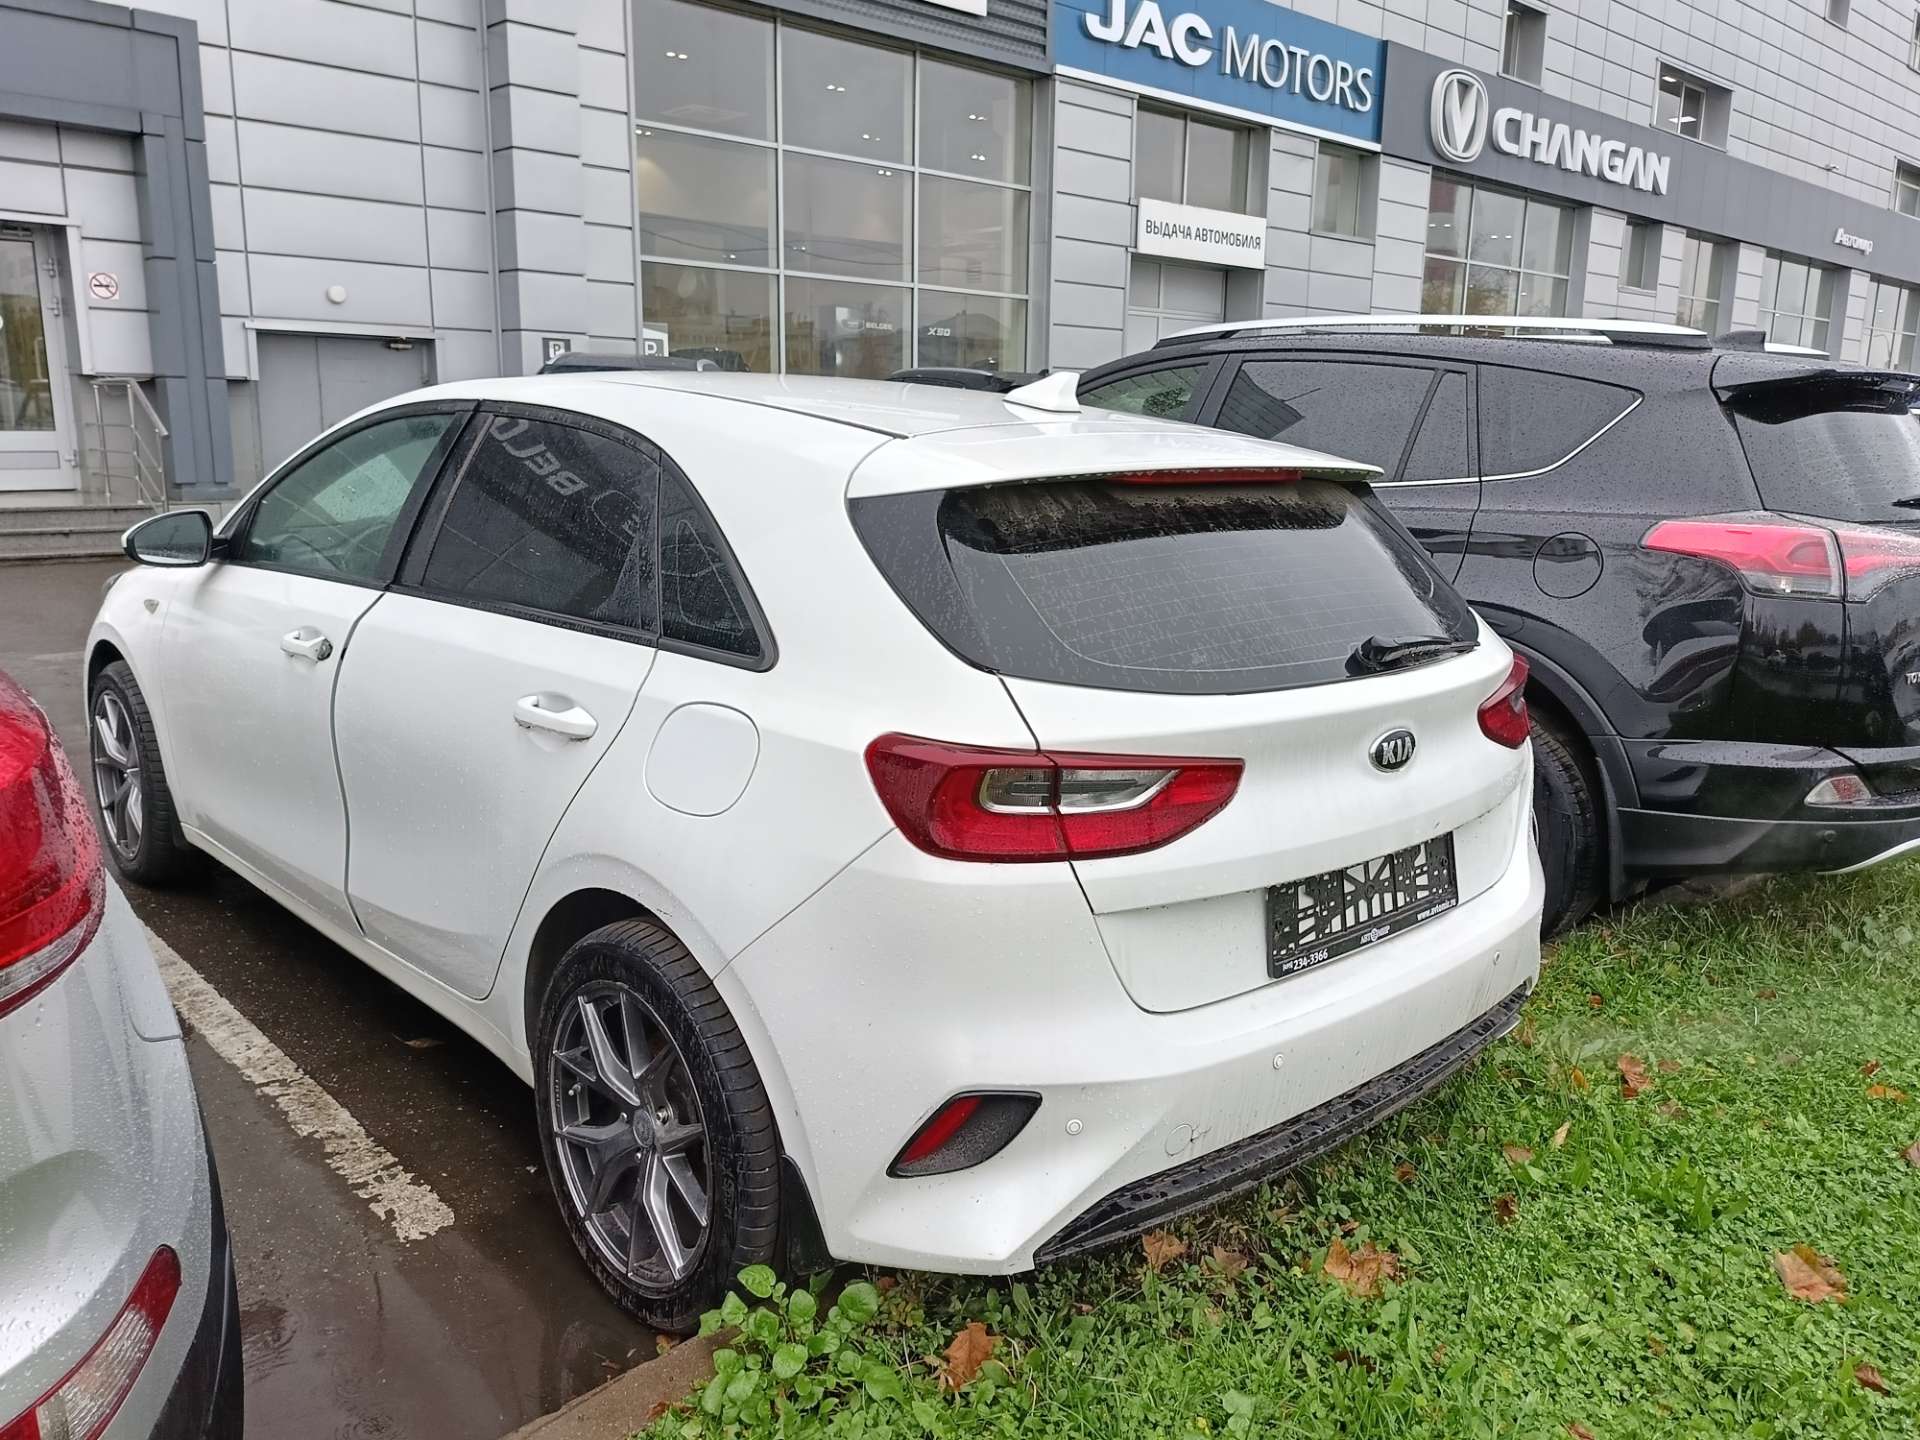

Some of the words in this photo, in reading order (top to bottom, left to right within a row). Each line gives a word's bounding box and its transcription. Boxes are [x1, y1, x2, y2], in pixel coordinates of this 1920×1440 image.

[1084, 0, 1213, 66] JAC
[1222, 25, 1373, 112] MOTORS
[1493, 107, 1671, 195] CHANGAN
[1145, 219, 1192, 240] ВЫДАЧА
[1194, 227, 1261, 250] АВТОМОБИЛЯ
[1381, 736, 1412, 765] KIA
[1293, 949, 1329, 970] 234-3366
